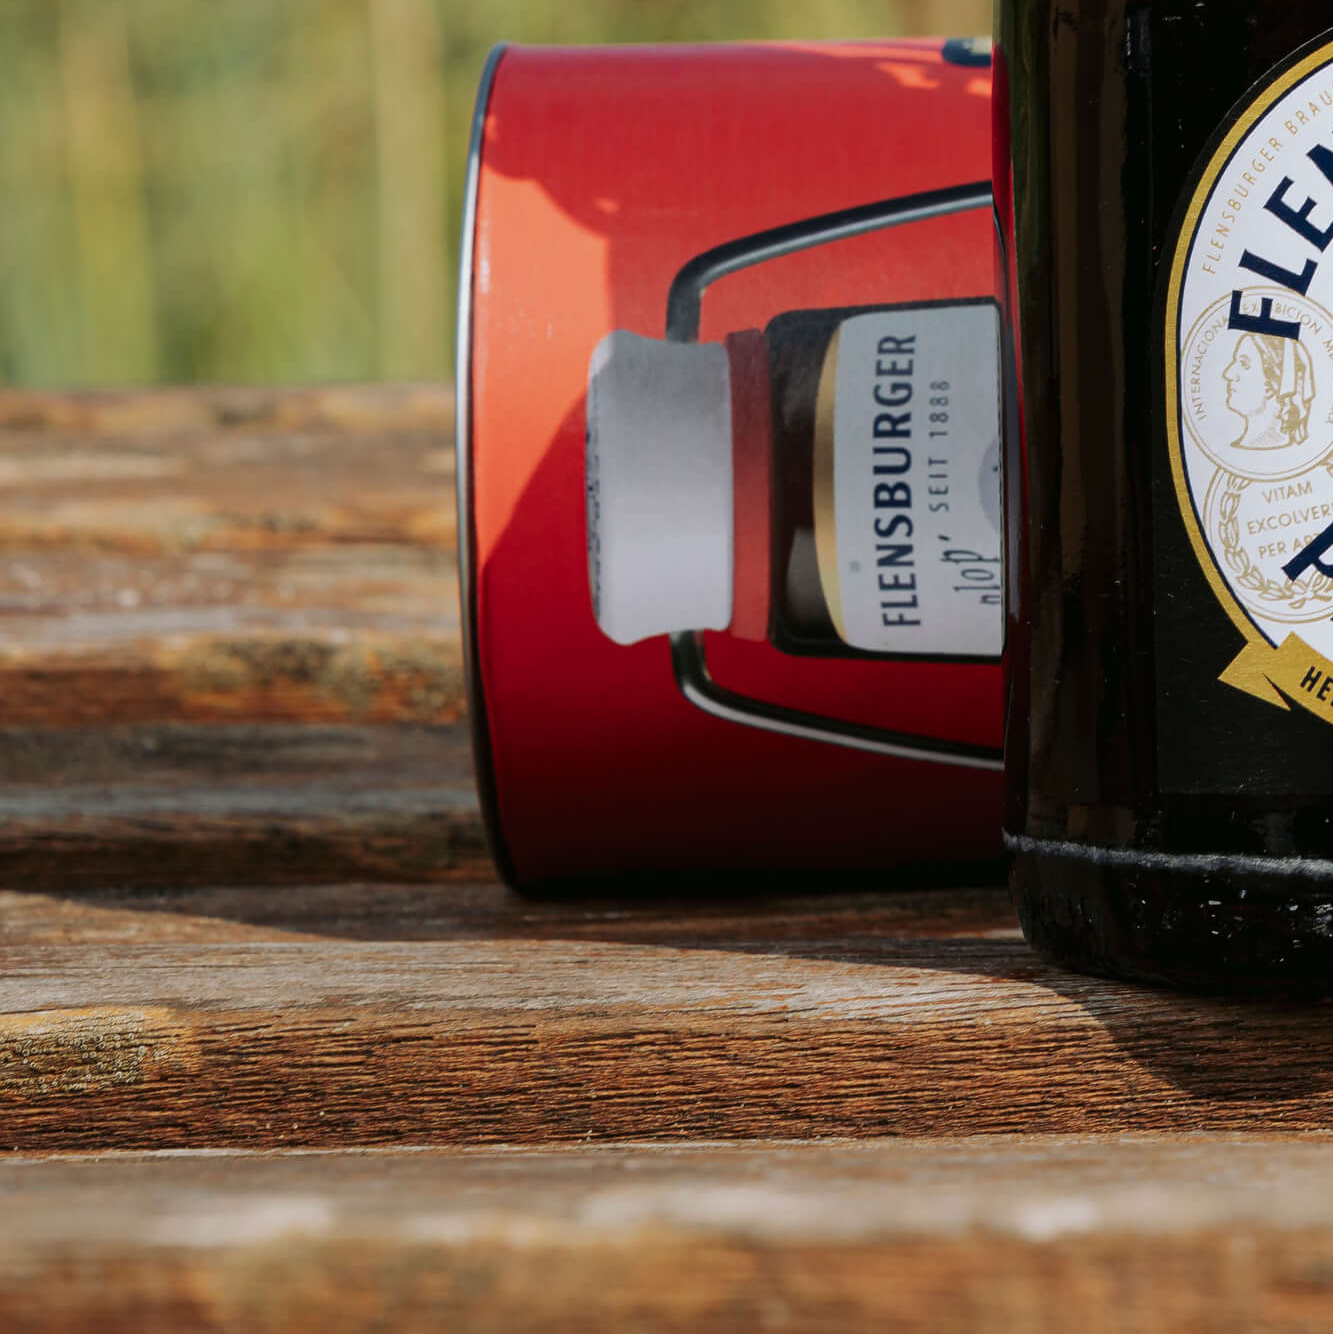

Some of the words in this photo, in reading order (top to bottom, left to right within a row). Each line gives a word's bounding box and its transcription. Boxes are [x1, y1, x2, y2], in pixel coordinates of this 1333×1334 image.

[1202, 136, 1283, 275] FLENSBURGER
[930, 380, 951, 443] 1888
[874, 333, 923, 628] FLENSBURGER
[929, 456, 951, 514] SEIT
[1261, 481, 1313, 504] VITAM
[1257, 541, 1288, 560] PER
